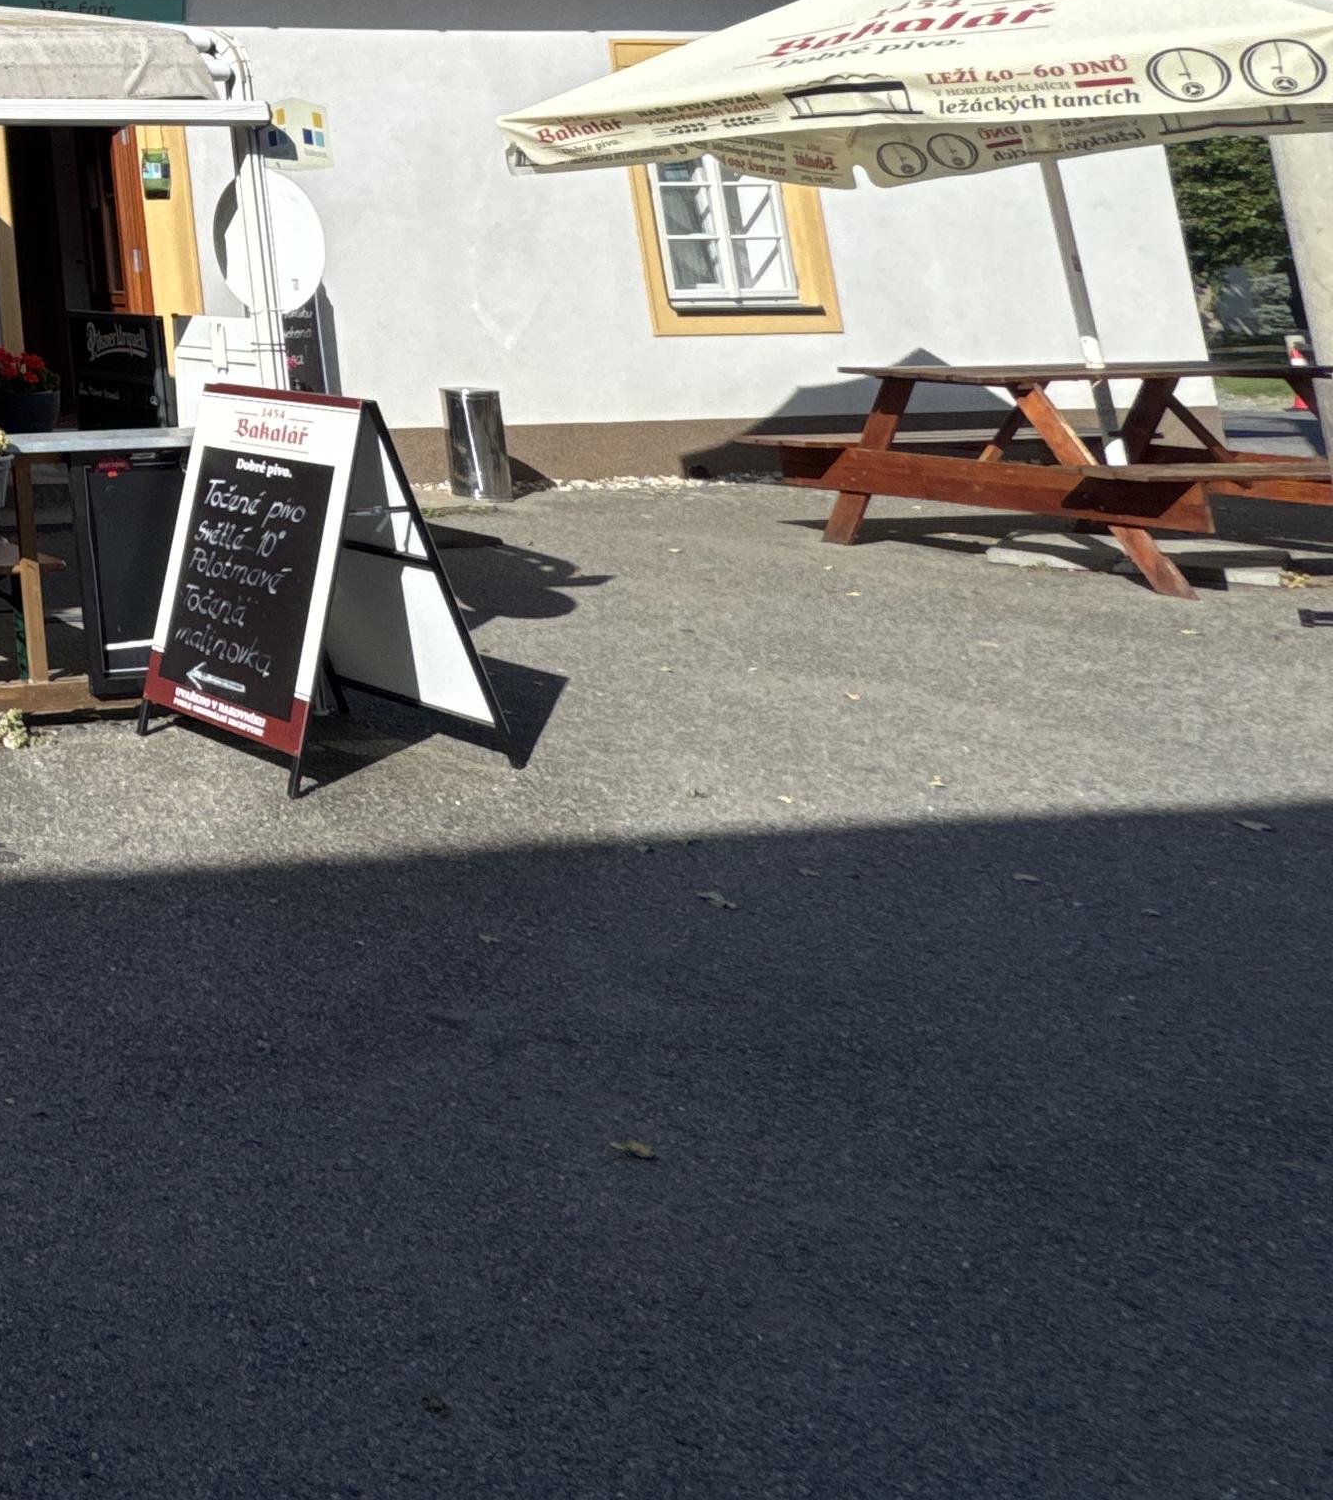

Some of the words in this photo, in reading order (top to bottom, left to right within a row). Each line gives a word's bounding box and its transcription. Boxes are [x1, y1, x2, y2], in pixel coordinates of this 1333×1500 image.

[763, 2, 1056, 57] Bakalář
[773, 43, 870, 69] Dobré
[925, 67, 979, 85] LEŽÍ
[1069, 54, 1128, 76] DNŮ
[938, 94, 1047, 114] ležáckých
[1053, 88, 1142, 108] tancích
[945, 81, 1071, 97] HORIZONTÁLNÍCH
[536, 118, 622, 143] Bakalář
[261, 407, 286, 420] 1454
[234, 418, 309, 446] Bakalář
[235, 457, 266, 474] Dobré
[266, 463, 293, 479] pivo.
[204, 479, 267, 516] Točené
[261, 498, 306, 528] pivo
[194, 520, 253, 551] Světlé
[255, 530, 287, 558] 10°
[189, 547, 293, 595] Polotmavé
[175, 623, 271, 678] malinovka
